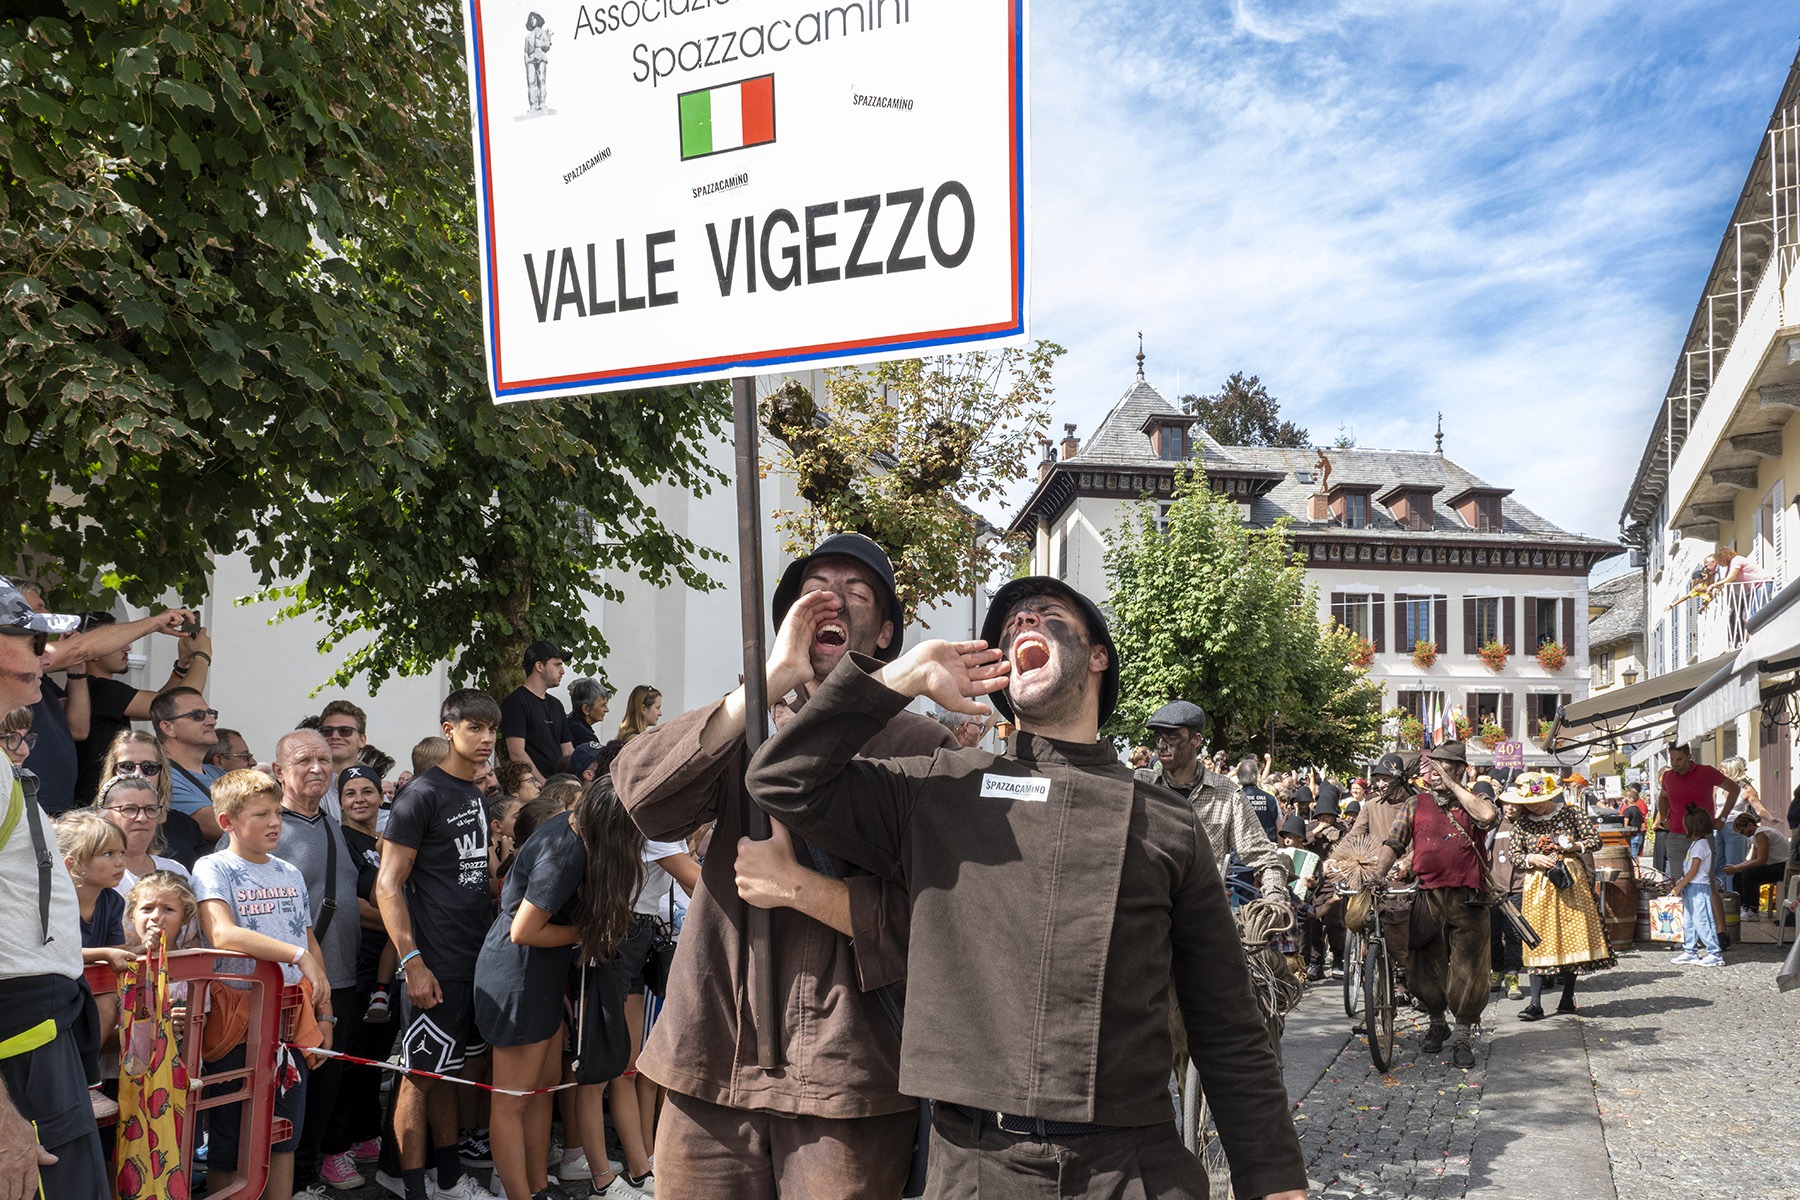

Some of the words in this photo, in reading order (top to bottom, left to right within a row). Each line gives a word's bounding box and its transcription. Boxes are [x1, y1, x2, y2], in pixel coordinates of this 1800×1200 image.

[523, 229, 679, 323] VALLE
[705, 180, 976, 298] VIGEZZO
[237, 886, 299, 903] SUMMER
[238, 902, 276, 917] TRIP
